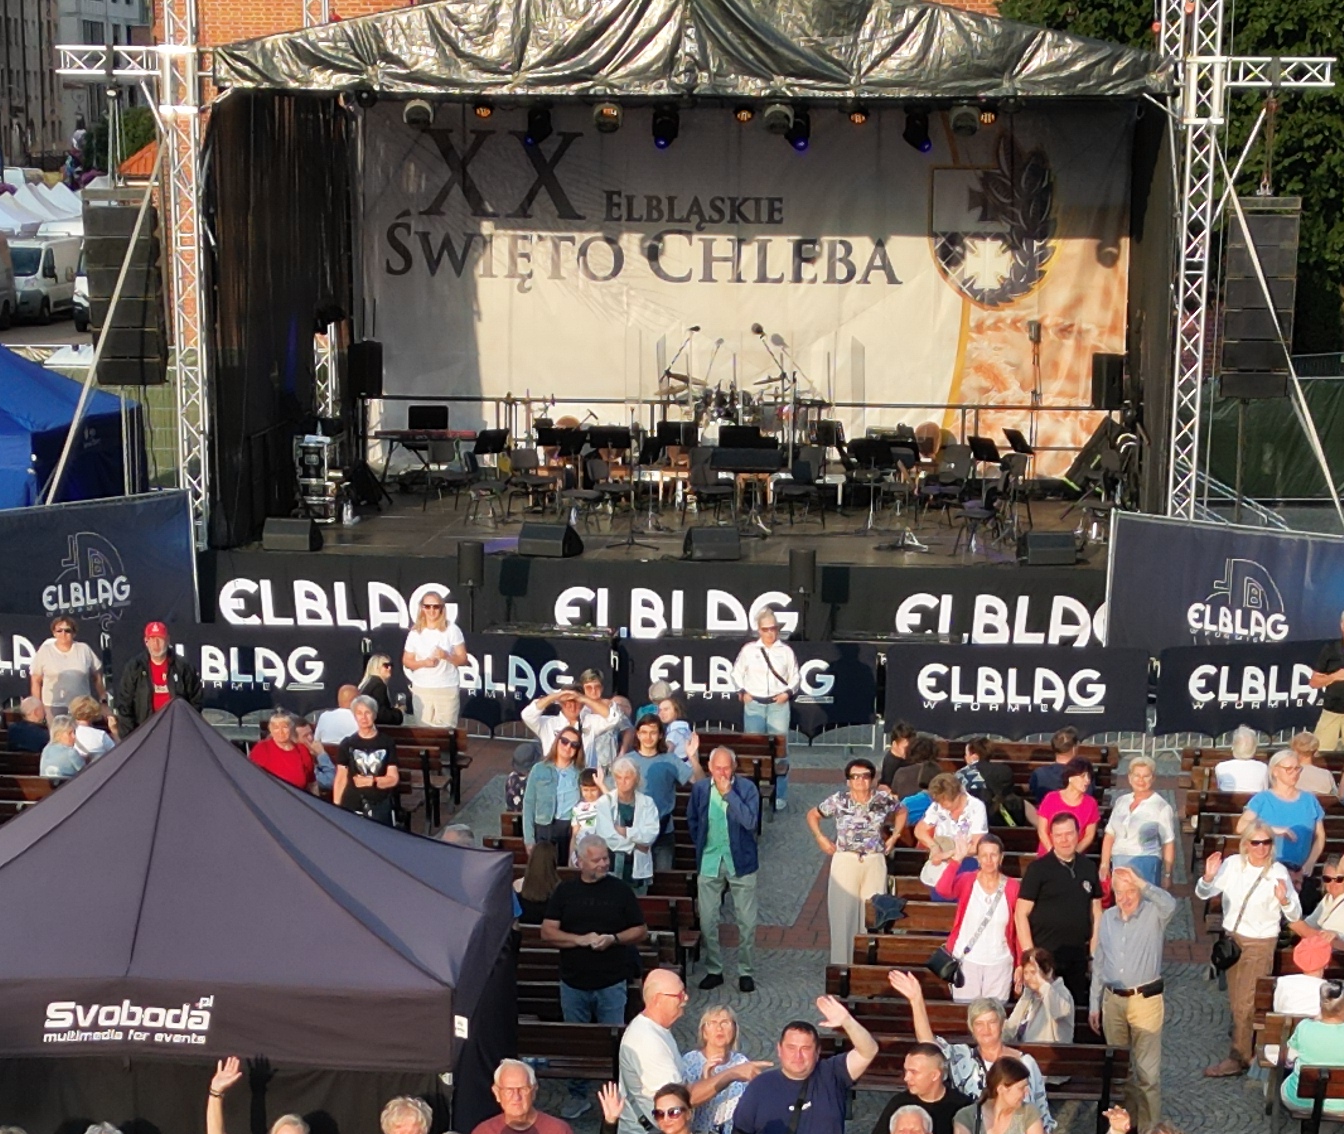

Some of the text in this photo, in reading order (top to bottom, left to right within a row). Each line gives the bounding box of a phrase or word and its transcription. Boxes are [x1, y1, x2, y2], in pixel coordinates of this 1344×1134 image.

[419, 127, 585, 221] XX
[385, 210, 904, 293] ŚWIĘTO CHLEBA
[43, 1030, 207, 1045] multimedia for events
